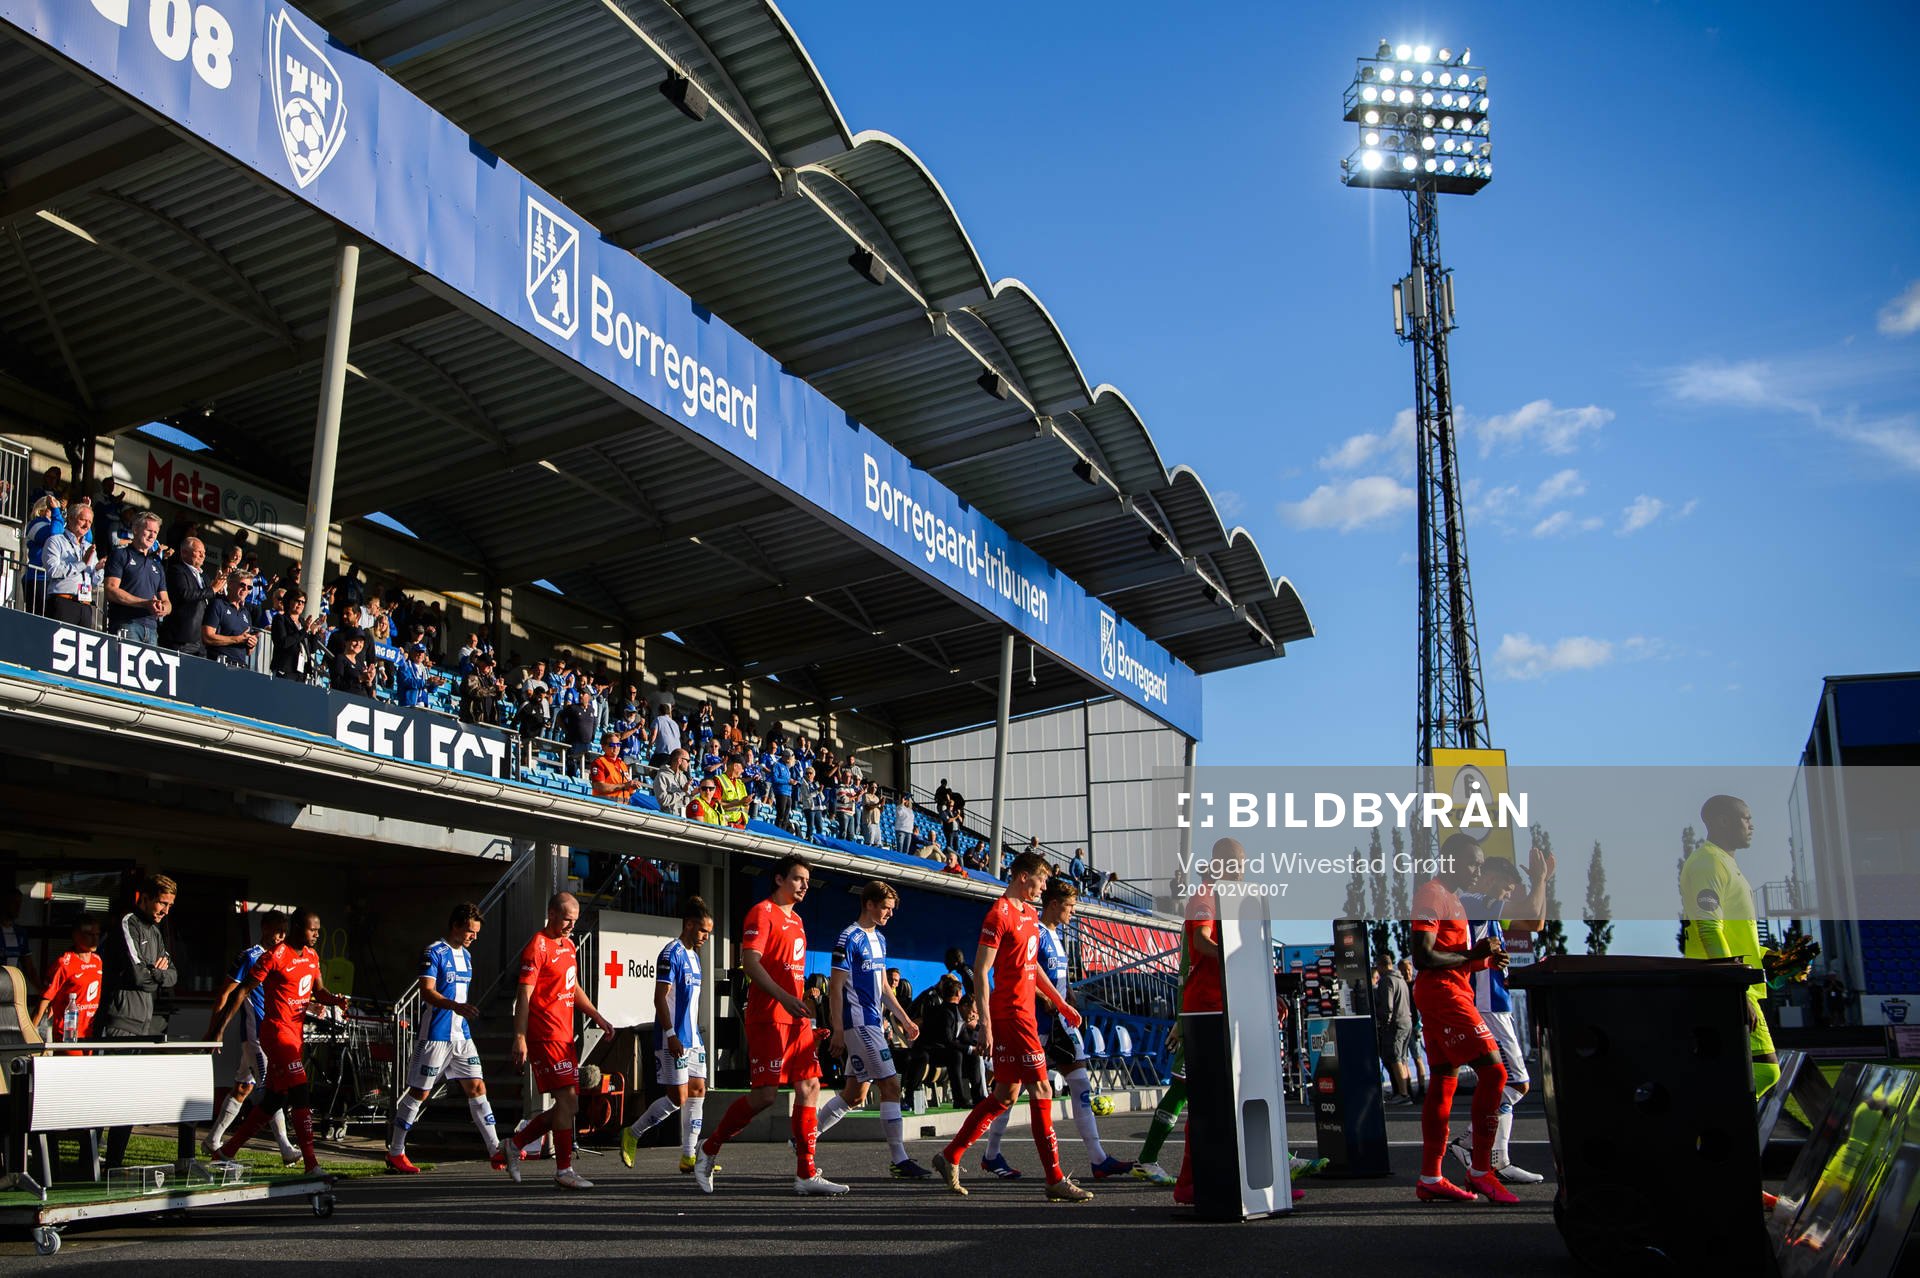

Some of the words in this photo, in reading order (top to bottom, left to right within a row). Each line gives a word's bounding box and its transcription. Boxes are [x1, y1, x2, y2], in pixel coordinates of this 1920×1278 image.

[149, 0, 234, 89] 08
[591, 274, 757, 440] Borregaard
[146, 450, 278, 536] Metacon
[863, 452, 1048, 624] Borregaard-tribunen
[52, 627, 181, 697] SELECT
[1117, 644, 1167, 705] Borregaard
[628, 959, 655, 979] Røde
